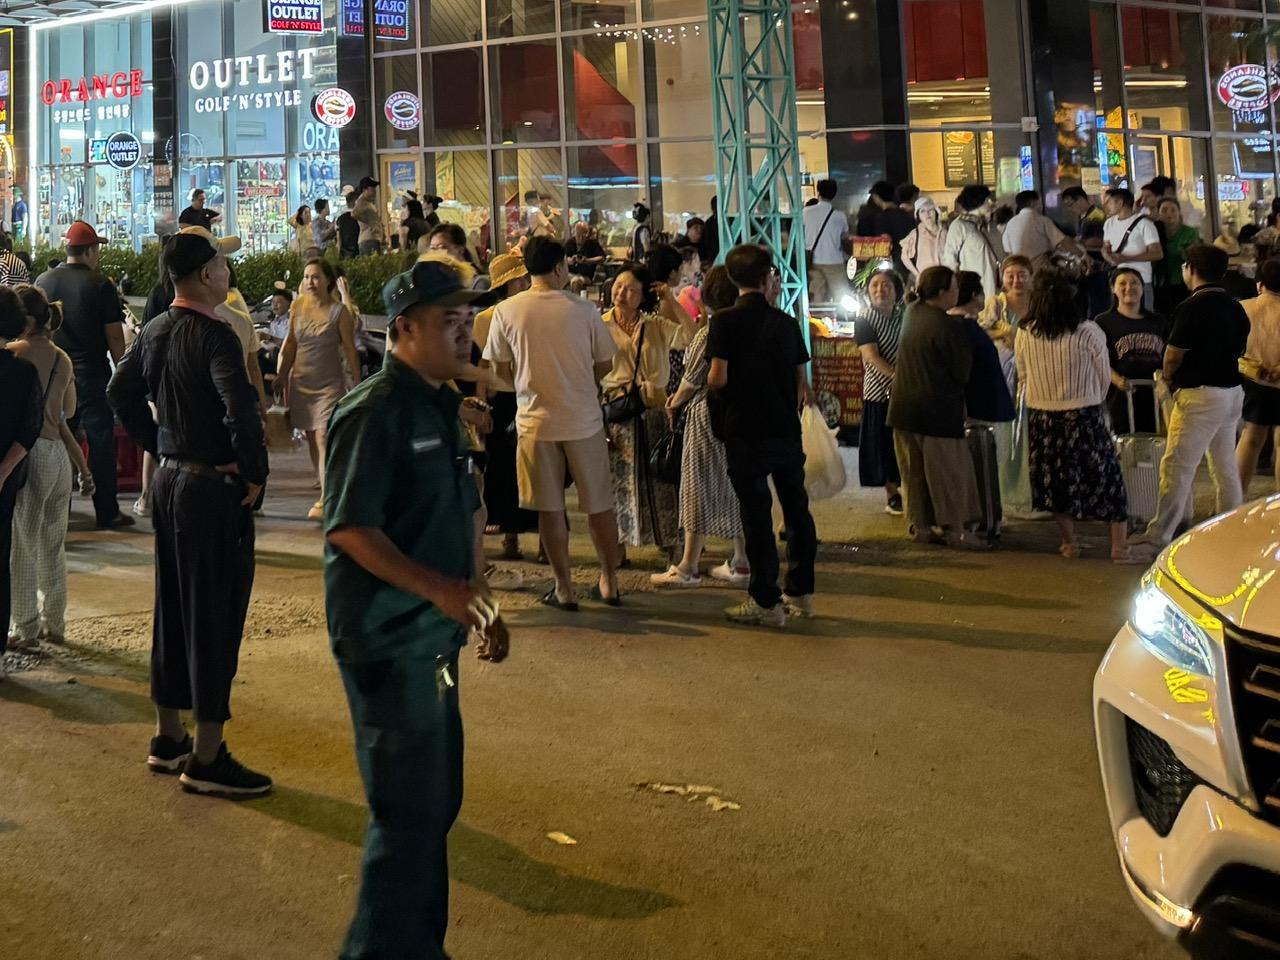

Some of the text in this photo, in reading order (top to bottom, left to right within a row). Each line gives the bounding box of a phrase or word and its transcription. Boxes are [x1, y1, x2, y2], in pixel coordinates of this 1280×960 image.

[272, 5, 319, 21] OUTLET
[189, 47, 317, 90] OUTLET
[41, 68, 145, 106] ORANGE
[109, 141, 138, 151] ORANGE
[111, 151, 137, 161] OUTLET
